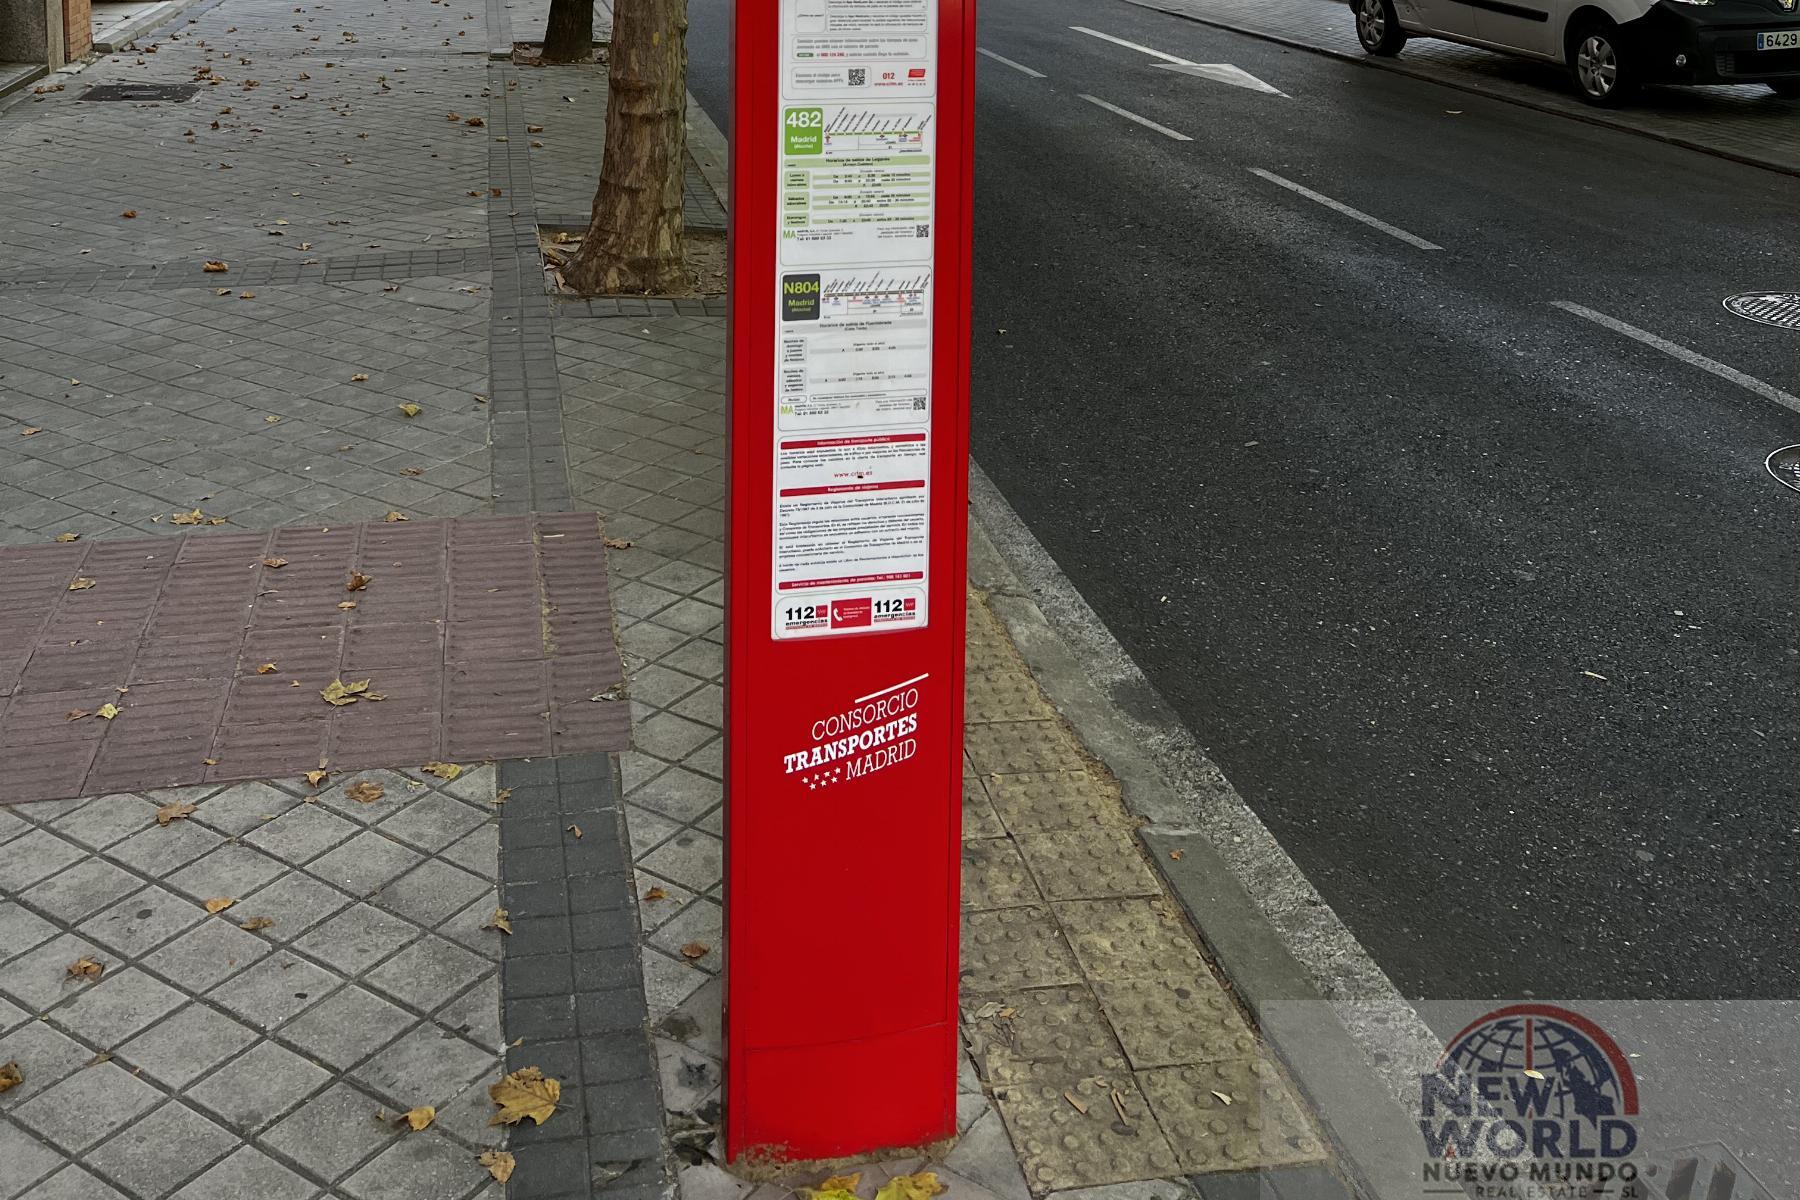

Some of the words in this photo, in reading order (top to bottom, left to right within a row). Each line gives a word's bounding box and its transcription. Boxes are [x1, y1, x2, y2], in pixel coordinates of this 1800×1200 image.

[1766, 33, 1798, 48] 6429
[882, 72, 895, 80] 012
[786, 111, 821, 128] 482
[790, 135, 817, 143] Madrid
[783, 281, 820, 294] N804
[788, 299, 815, 307] Madrid
[786, 606, 815, 621] 112
[874, 599, 903, 614] 112
[811, 688, 919, 741] CONSORCIO
[783, 712, 918, 774] TRANSPORTES
[845, 738, 917, 781] MADRID
